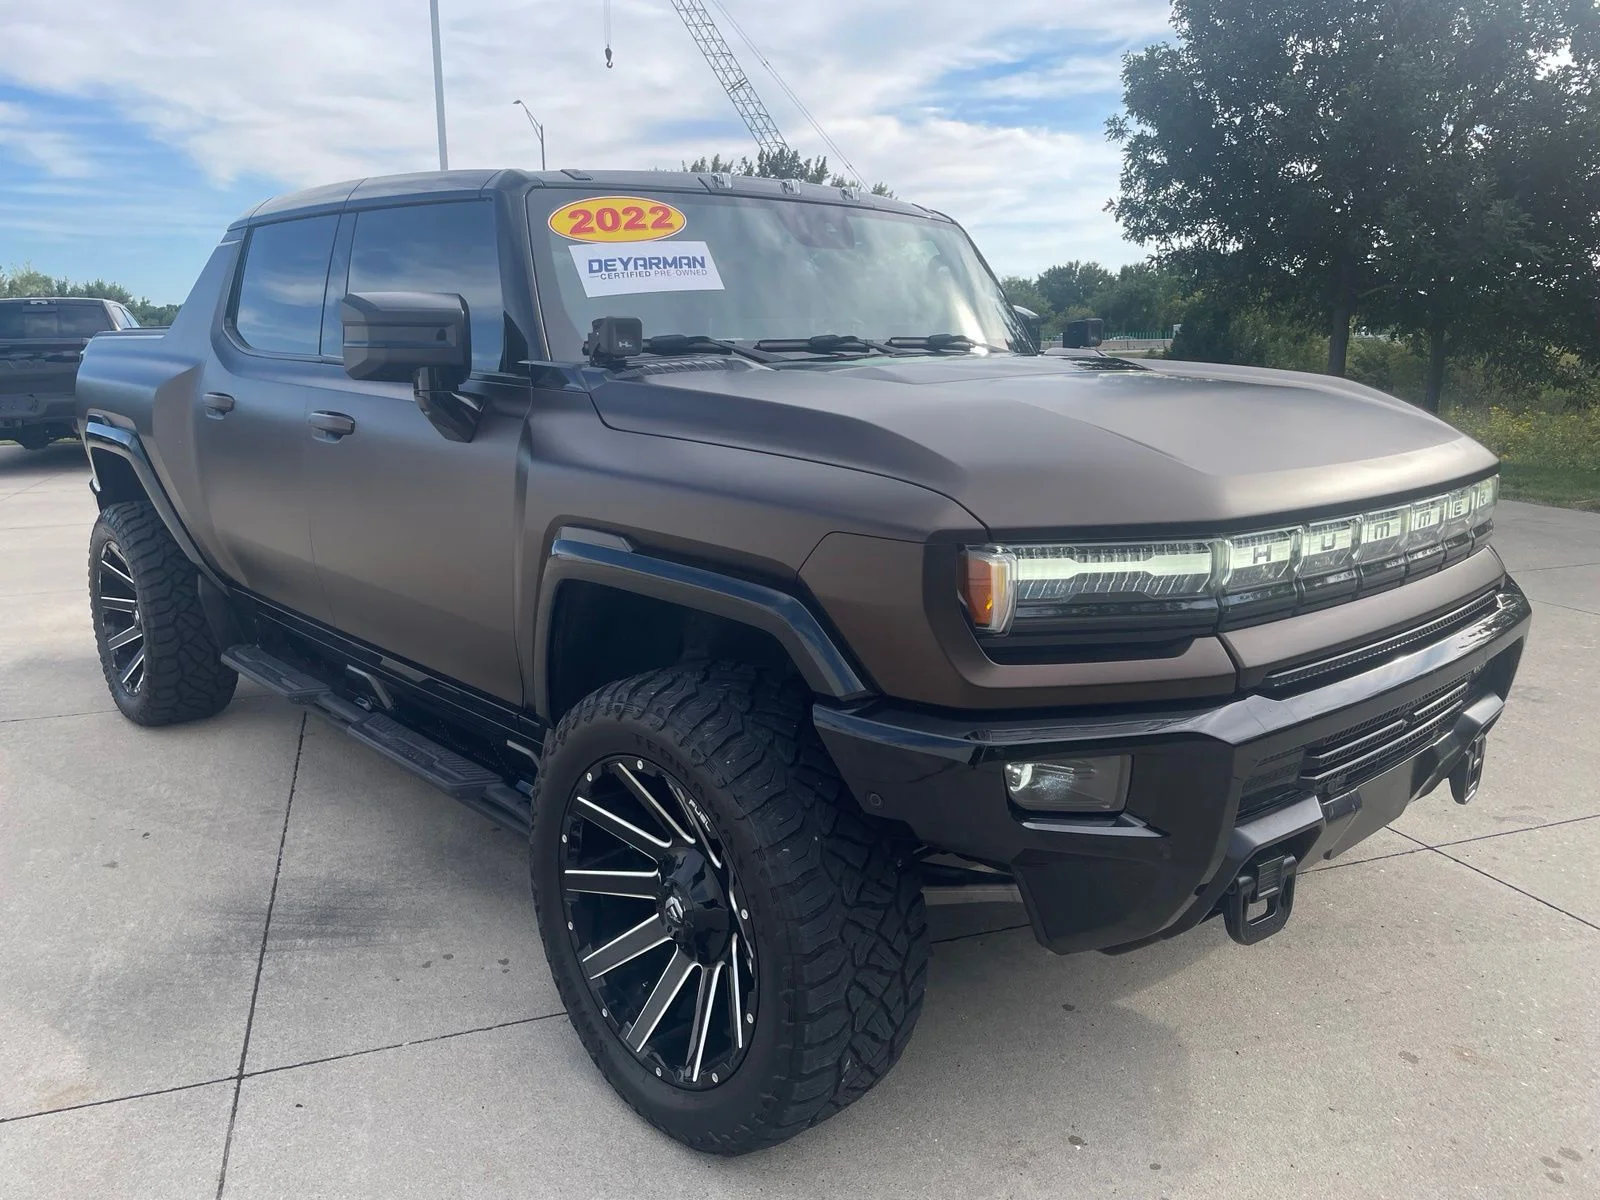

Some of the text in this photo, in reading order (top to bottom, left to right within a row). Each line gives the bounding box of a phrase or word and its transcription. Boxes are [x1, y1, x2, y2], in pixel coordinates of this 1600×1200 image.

[569, 206, 674, 235] 2022
[588, 255, 706, 274] DEYARMAN
[600, 268, 708, 280] CERTIFIED PRE-OWNED
[688, 798, 711, 832] FUEL
